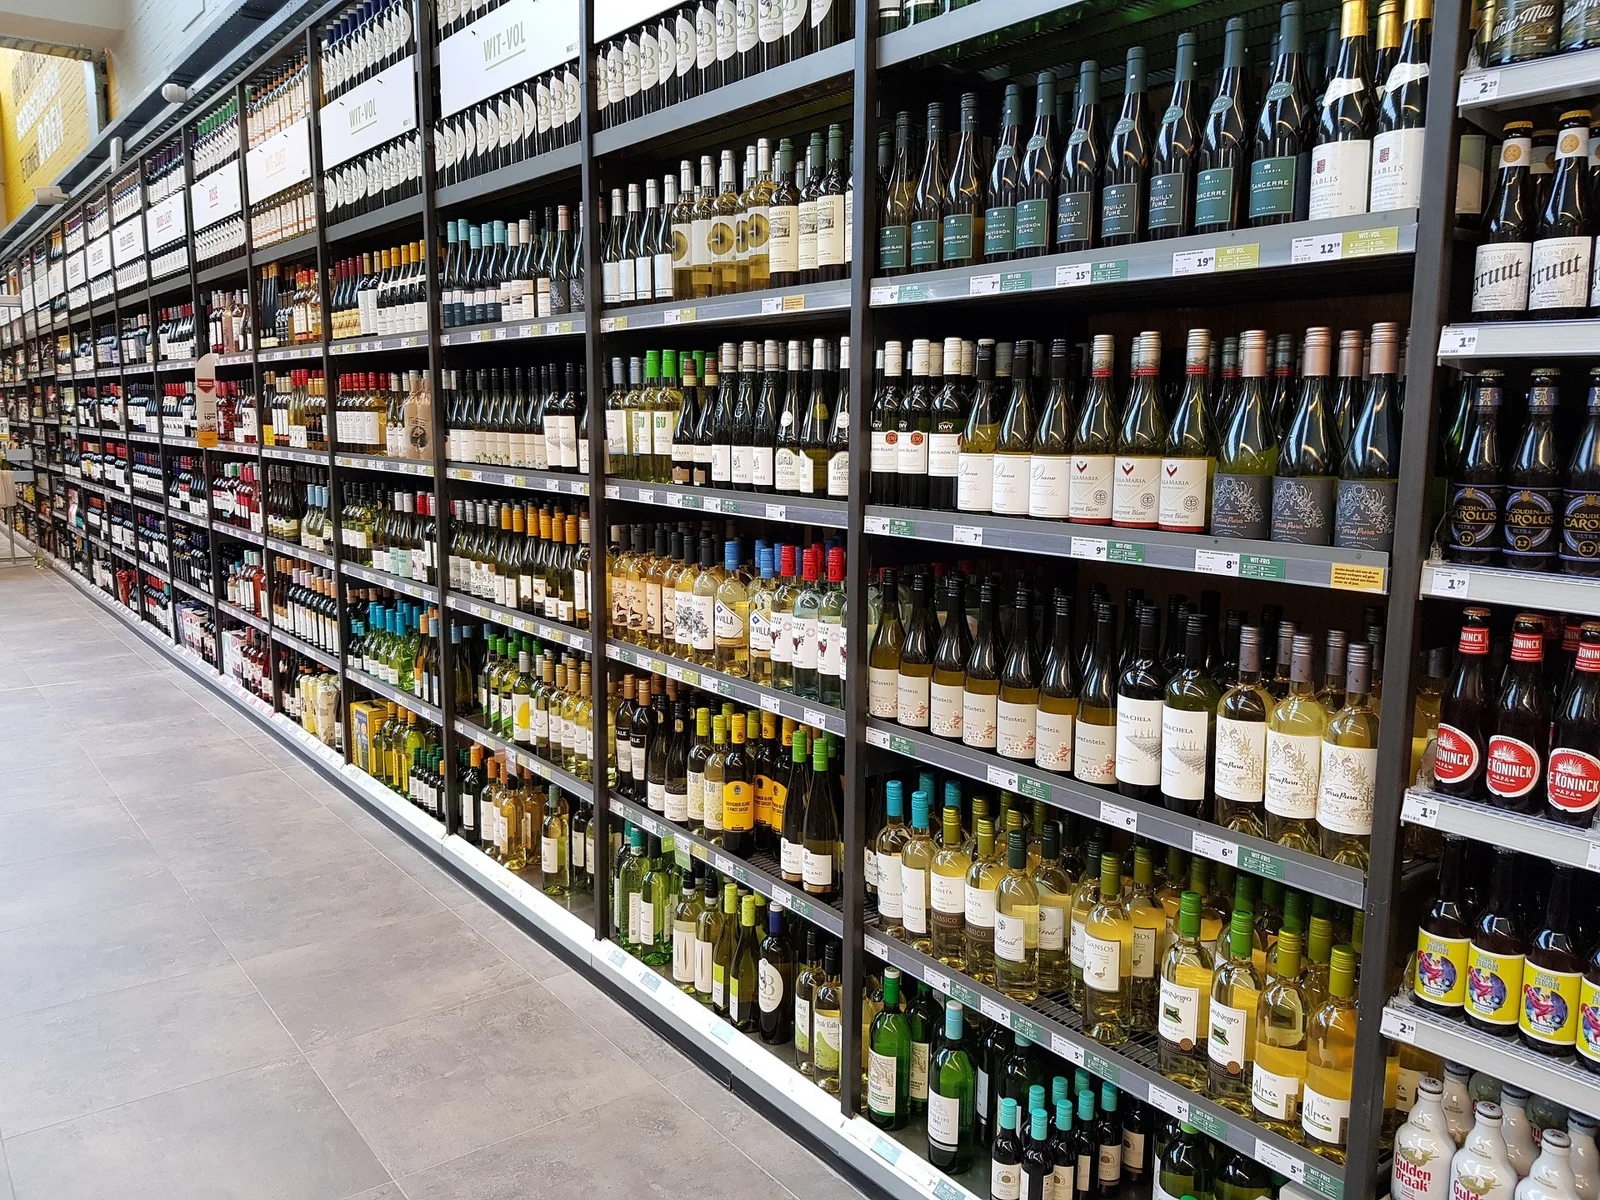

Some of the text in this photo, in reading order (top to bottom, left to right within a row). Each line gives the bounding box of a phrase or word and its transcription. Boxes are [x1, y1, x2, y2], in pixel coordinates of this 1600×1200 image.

[484, 21, 525, 62] WIT-VOL
[1270, 87, 1286, 96] 2017
[349, 97, 377, 128] WIT-VOL
[1251, 179, 1289, 190] SANCERRE
[1103, 203, 1127, 211] POUILLY
[1358, 231, 1380, 239] WIT-VOL
[1226, 247, 1245, 255] WIT-VOL
[1473, 258, 1523, 296] gruut
[1530, 252, 1582, 293] gruut
[938, 423, 954, 431] KWV
[1129, 714, 1151, 722] CHELA
[1172, 726, 1194, 734] CHELA
[1086, 939, 1114, 953] GANSOS
[1253, 1076, 1277, 1098] Alpaca
[1304, 1099, 1331, 1121] Alpaca
[1395, 1152, 1431, 1181] Gulden
[1310, 1168, 1331, 1183] WIT-FRIS
[1395, 1167, 1428, 1192] Draak
